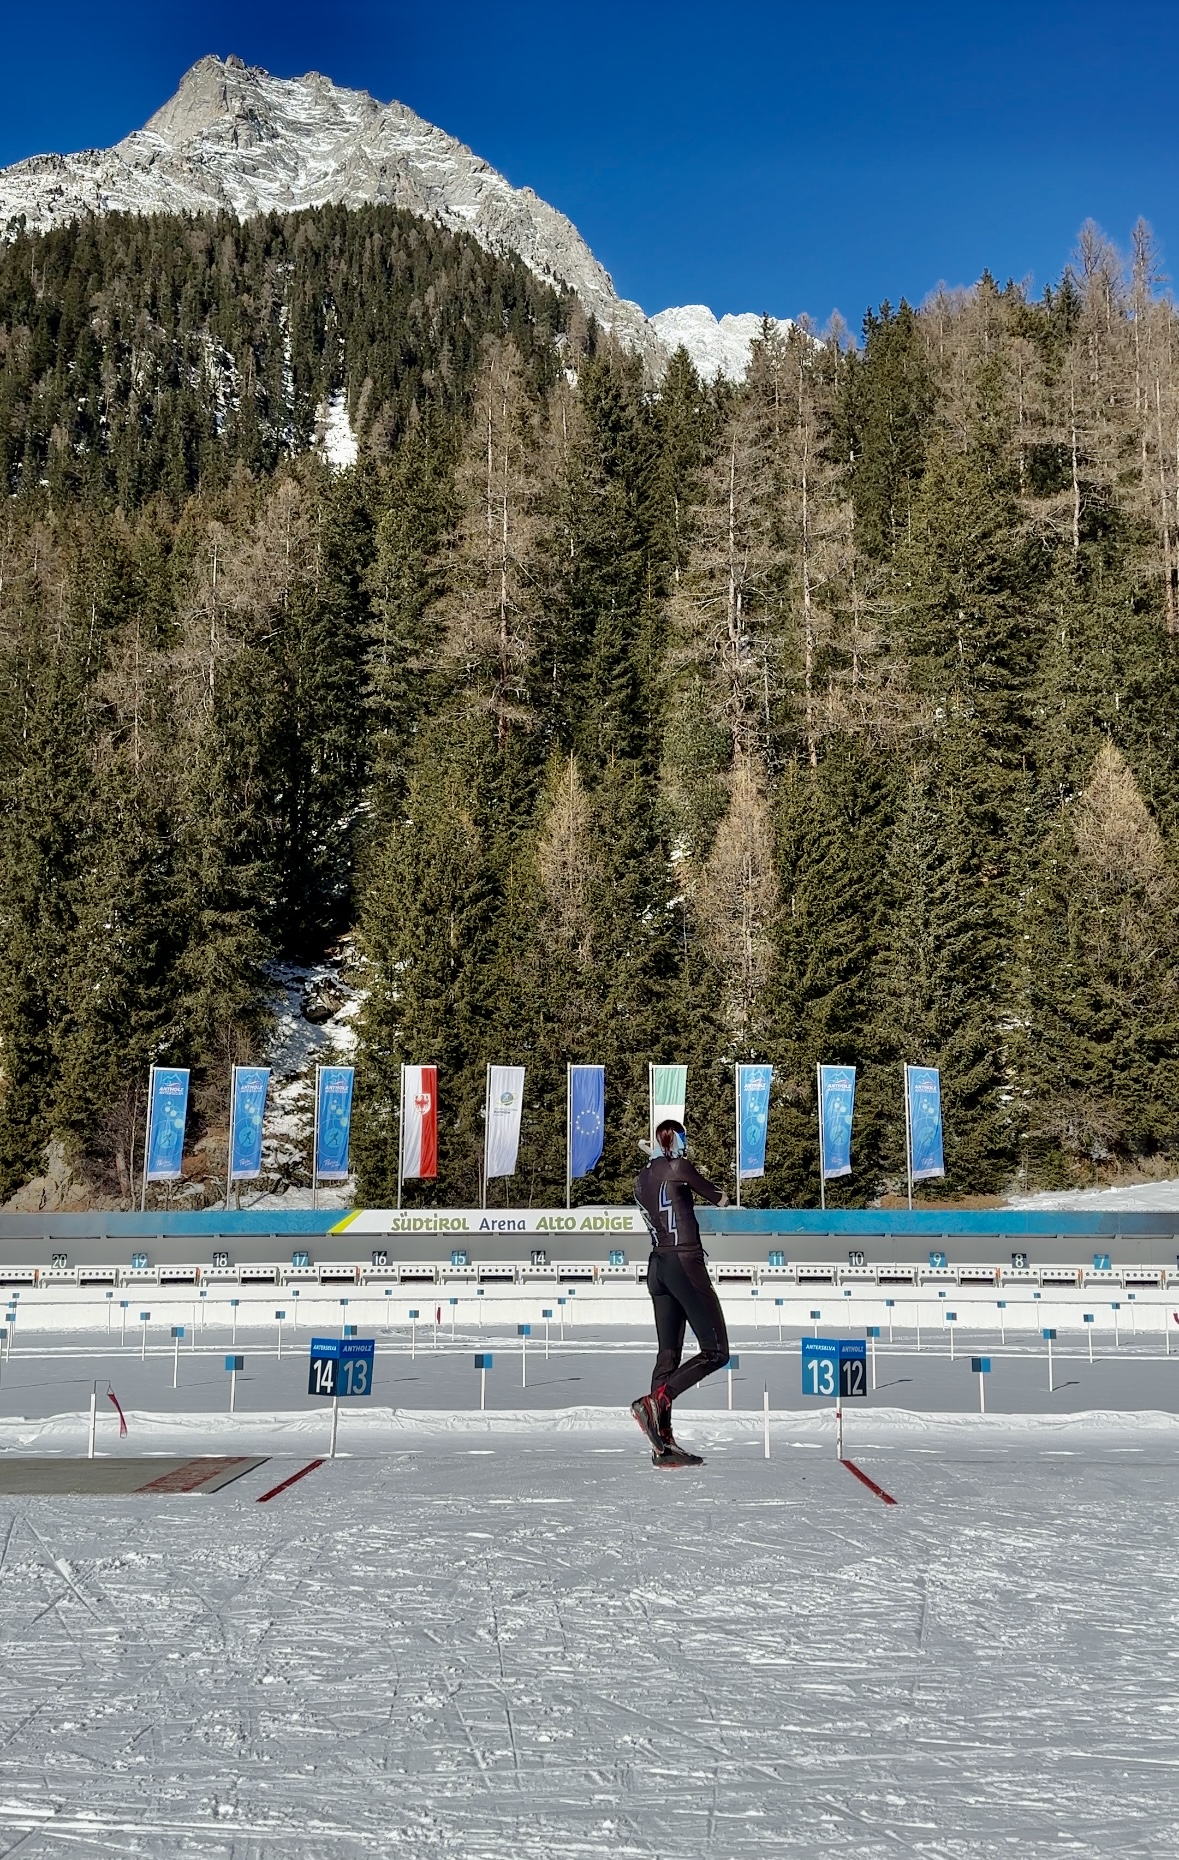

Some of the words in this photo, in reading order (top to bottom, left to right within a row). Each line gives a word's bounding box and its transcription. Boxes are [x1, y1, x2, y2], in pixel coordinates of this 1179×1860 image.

[479, 1217, 526, 1231] Arena
[535, 1216, 576, 1231] ALTO
[580, 1211, 634, 1231] ADIGE
[52, 1254, 67, 1269] 20
[133, 1253, 147, 1268] 19
[213, 1252, 228, 1267] 18
[293, 1252, 308, 1266] 17
[373, 1251, 387, 1266] 16
[452, 1251, 466, 1265] 15
[531, 1251, 546, 1265] 14
[610, 1251, 624, 1265] 13
[770, 1251, 783, 1265] 11
[849, 1252, 864, 1266] 10
[933, 1252, 942, 1267] 9
[1015, 1253, 1024, 1268] 8
[1097, 1255, 1106, 1269] 7
[342, 1345, 372, 1353] ANTHOLZ
[805, 1344, 836, 1352] ANTERSELVA
[313, 1359, 334, 1393] 14
[343, 1359, 369, 1395] 13
[807, 1359, 835, 1395] 13
[842, 1360, 863, 1395] 12
